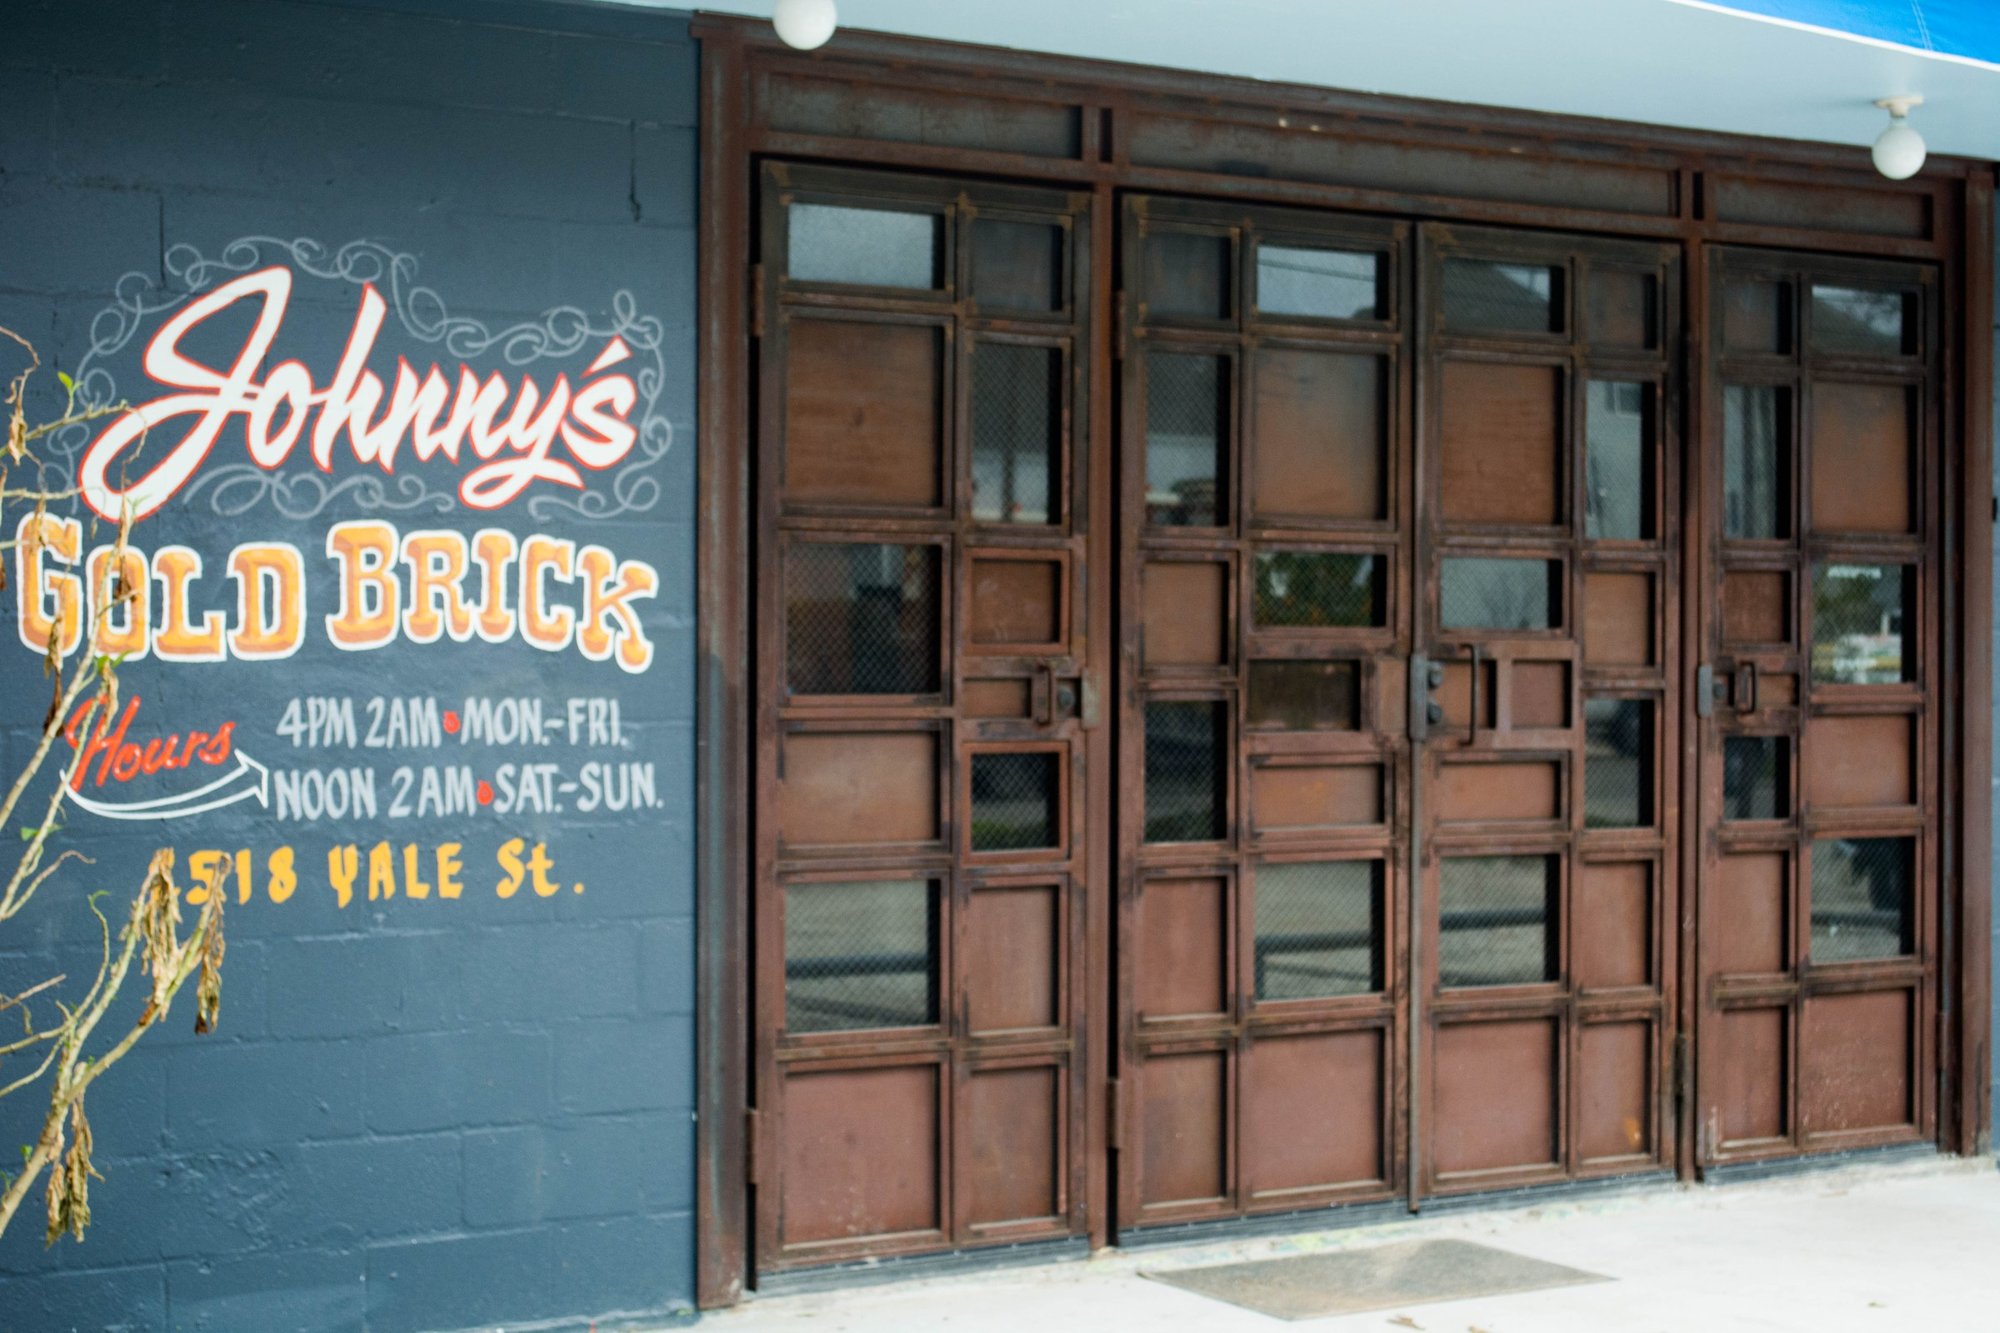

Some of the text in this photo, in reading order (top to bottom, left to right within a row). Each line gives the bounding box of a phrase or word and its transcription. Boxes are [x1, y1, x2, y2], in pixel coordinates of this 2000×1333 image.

[15, 511, 660, 675] GOLD BRICK
[64, 695, 237, 792] Hours
[276, 696, 358, 749] 4PM
[364, 696, 442, 749] 2AM
[273, 766, 378, 822] NOON
[388, 765, 476, 819] 2AM
[328, 840, 465, 909] YALE
